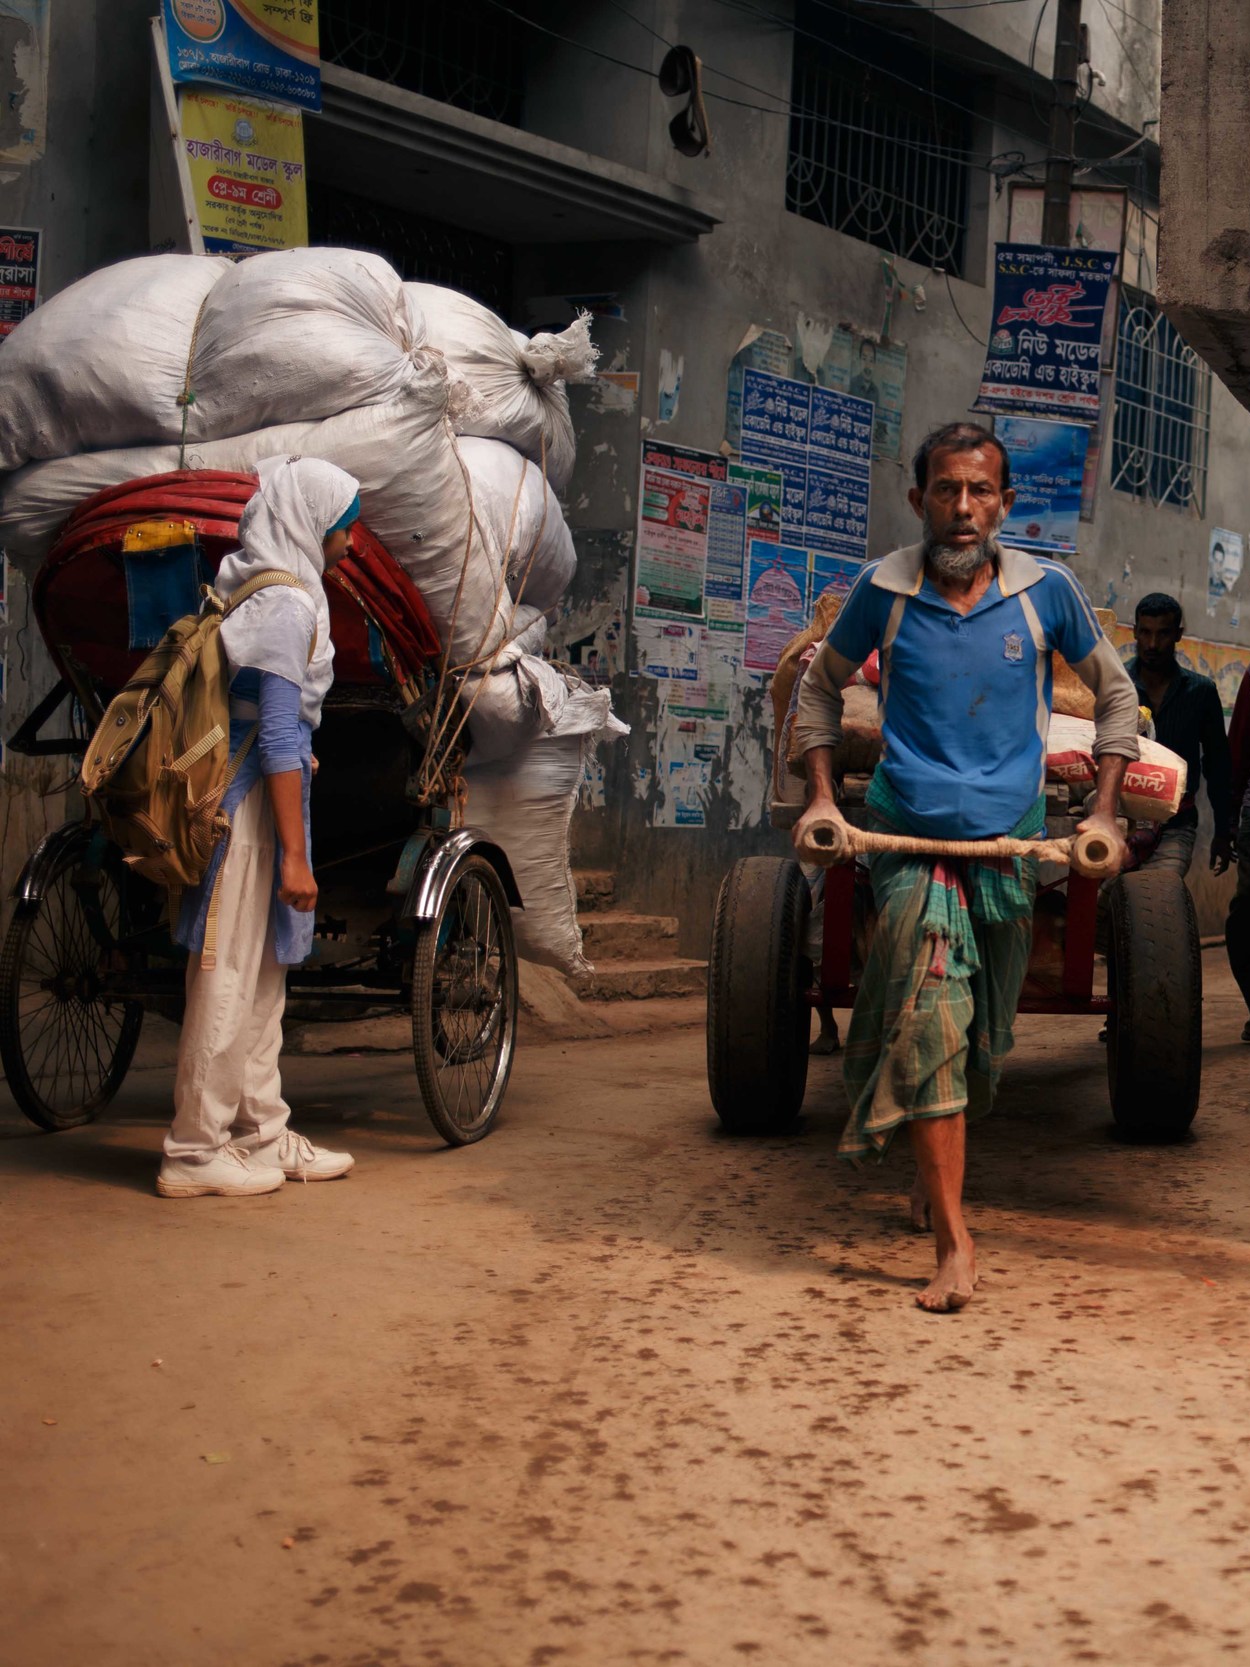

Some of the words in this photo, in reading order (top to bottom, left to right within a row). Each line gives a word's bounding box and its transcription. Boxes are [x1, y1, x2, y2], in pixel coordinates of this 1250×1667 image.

[186, 139, 241, 169] হাজারীবাগ
[245, 151, 277, 175] মডেল
[281, 160, 304, 183] স্কুল
[1061, 256, 1100, 271] J.S.C
[1016, 328, 1050, 357] নিউ
[1053, 338, 1101, 365] মডেল
[983, 355, 1032, 381] একাডেমি
[1033, 364, 1057, 382] এন্ড
[1059, 361, 1101, 393] হাইস্কুল
